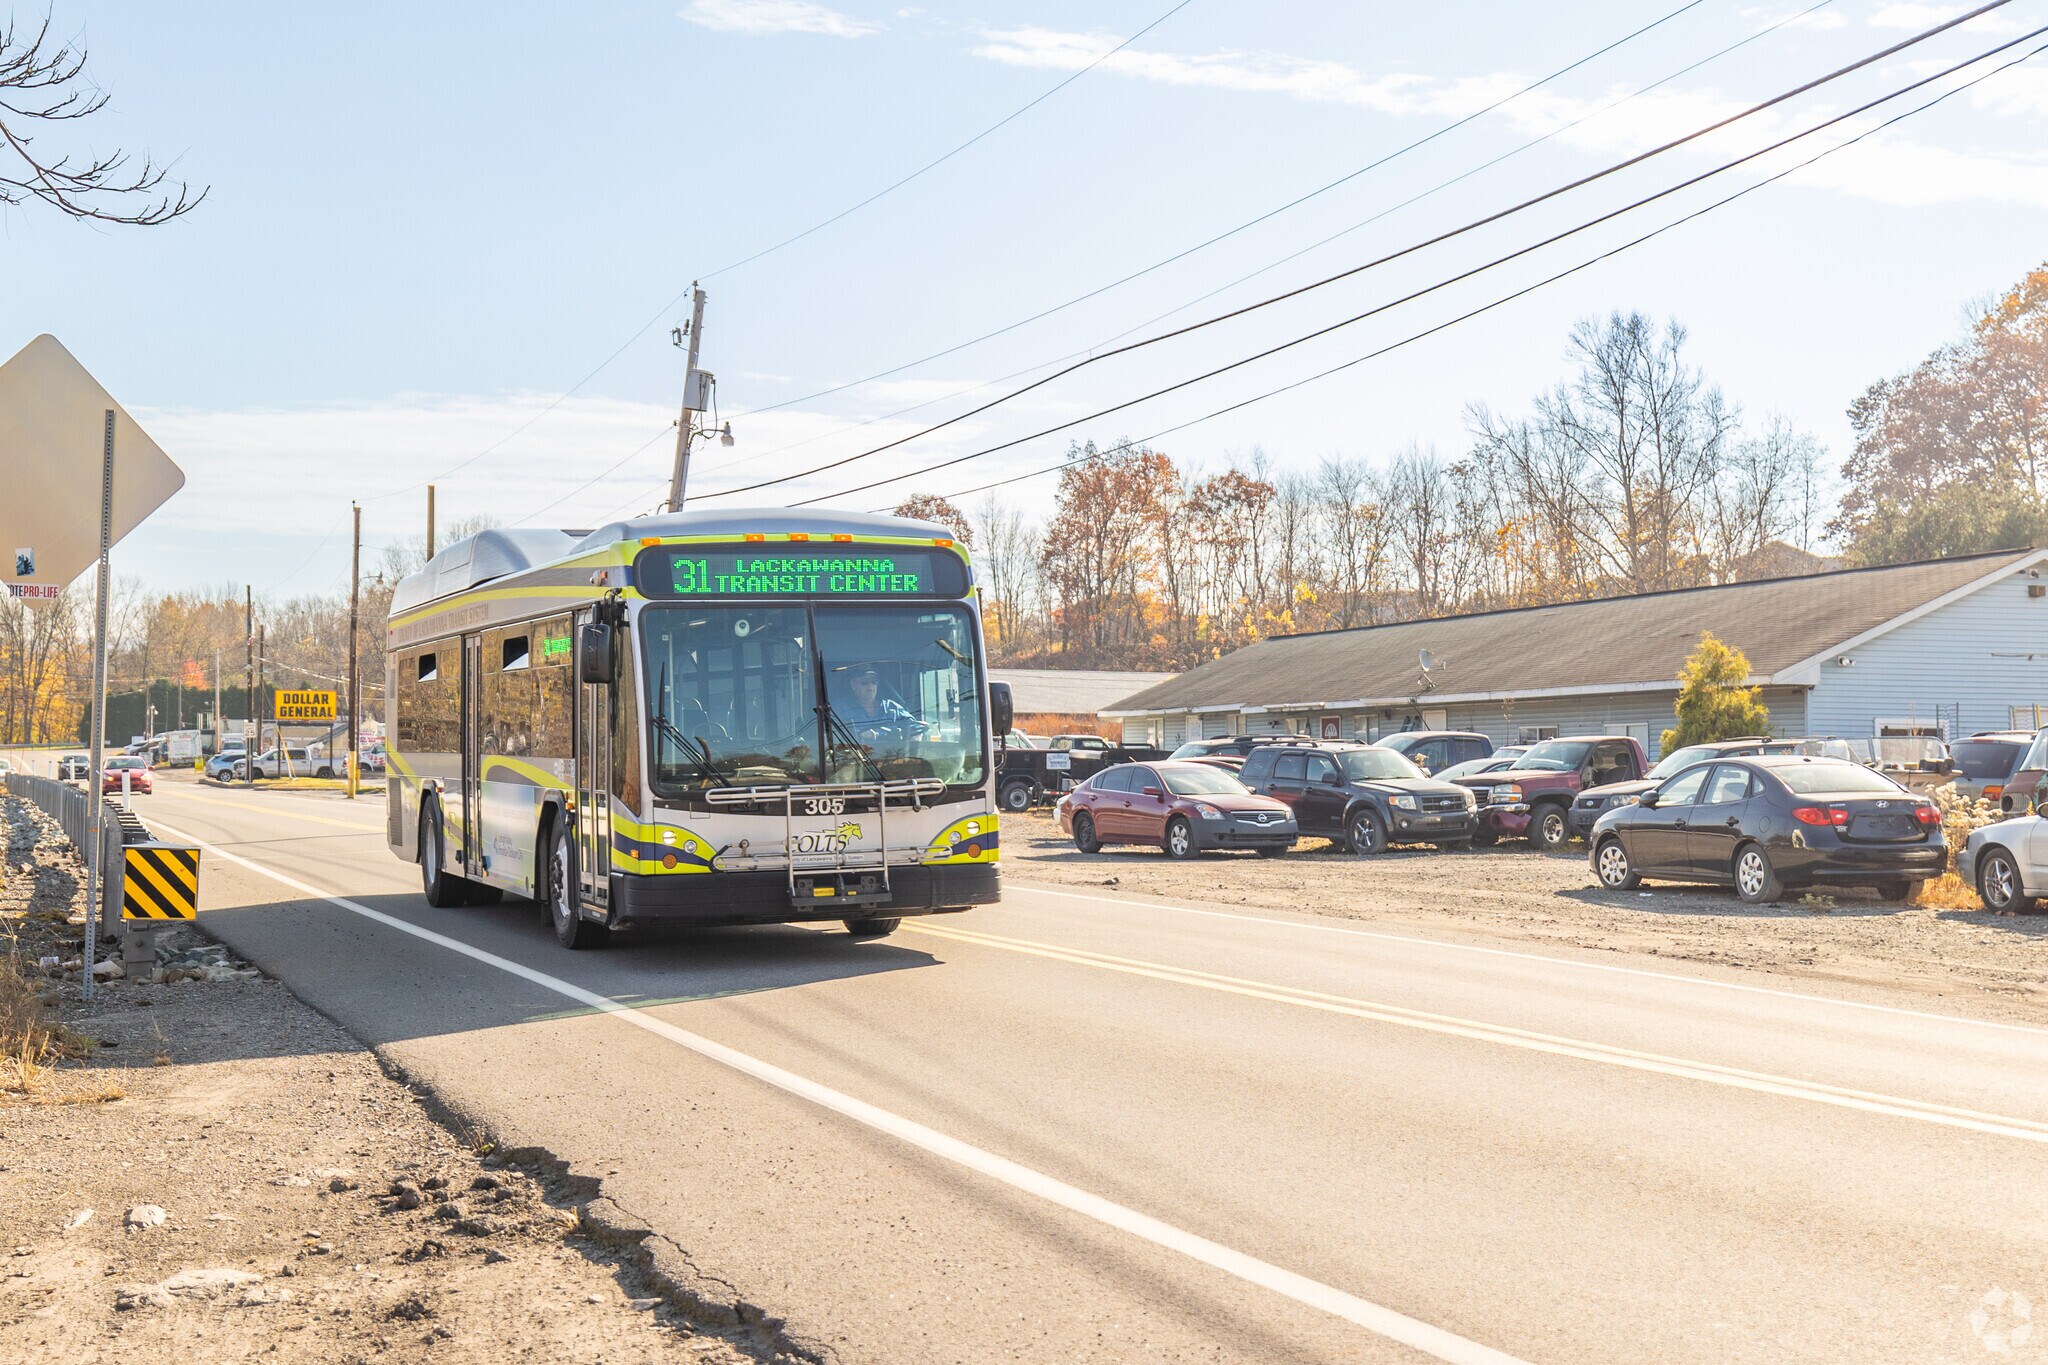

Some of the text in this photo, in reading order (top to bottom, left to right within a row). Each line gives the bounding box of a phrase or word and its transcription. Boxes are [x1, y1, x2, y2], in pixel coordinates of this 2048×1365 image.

[736, 559, 895, 573] LACKAWANNA
[674, 559, 712, 592] 31
[714, 574, 918, 592] TRANSIT CENTER
[283, 693, 329, 704] DOLLAR
[280, 706, 333, 717] GENERAL
[804, 798, 844, 815] 305
